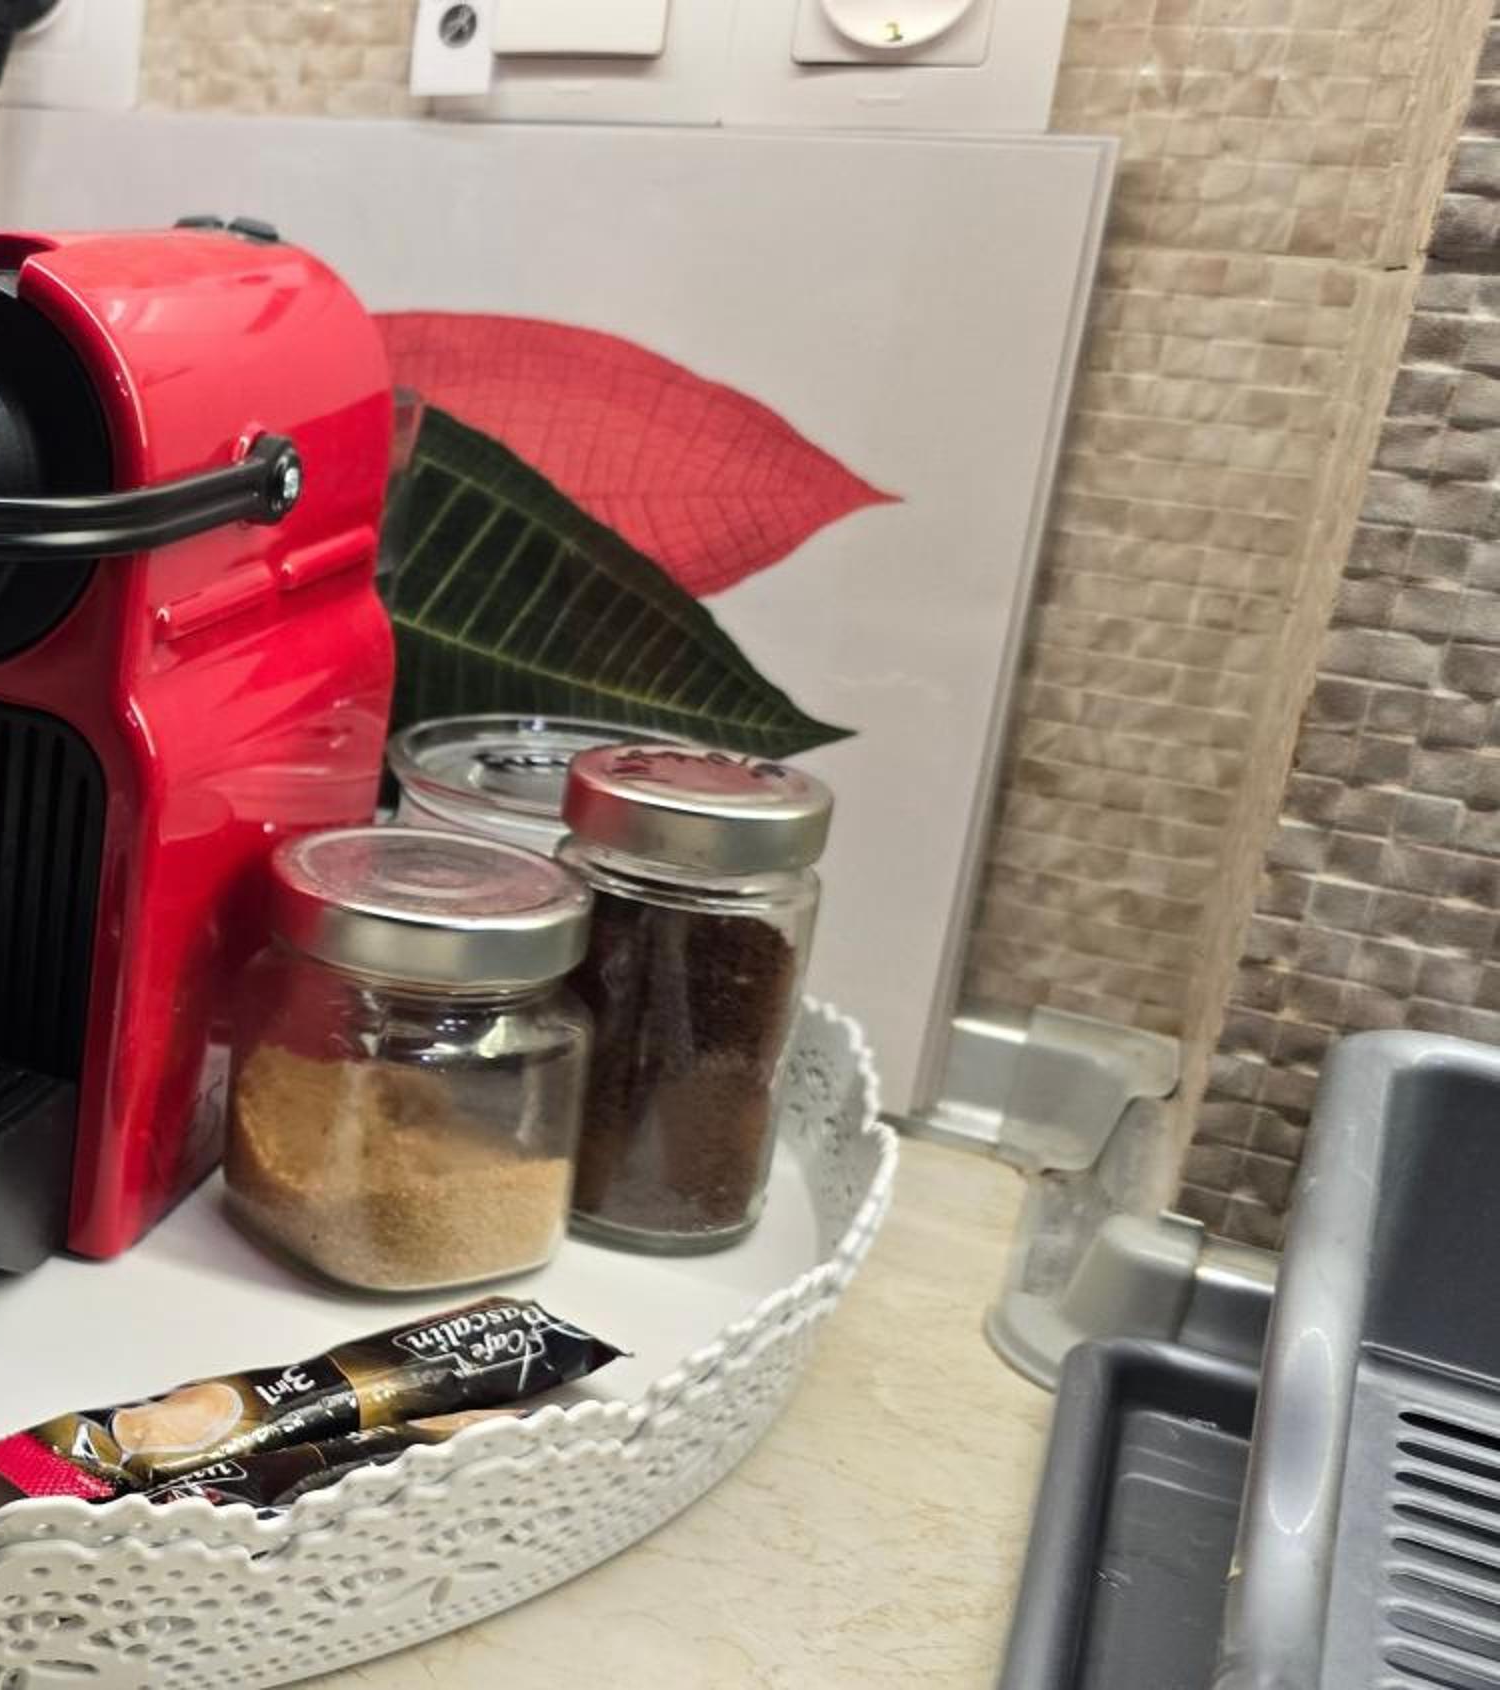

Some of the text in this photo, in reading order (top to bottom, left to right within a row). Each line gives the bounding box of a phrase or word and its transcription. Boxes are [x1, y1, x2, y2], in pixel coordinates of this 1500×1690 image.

[405, 1305, 550, 1353] Pascalin
[469, 1328, 525, 1361] Cafe
[254, 1365, 317, 1406] 3in1
